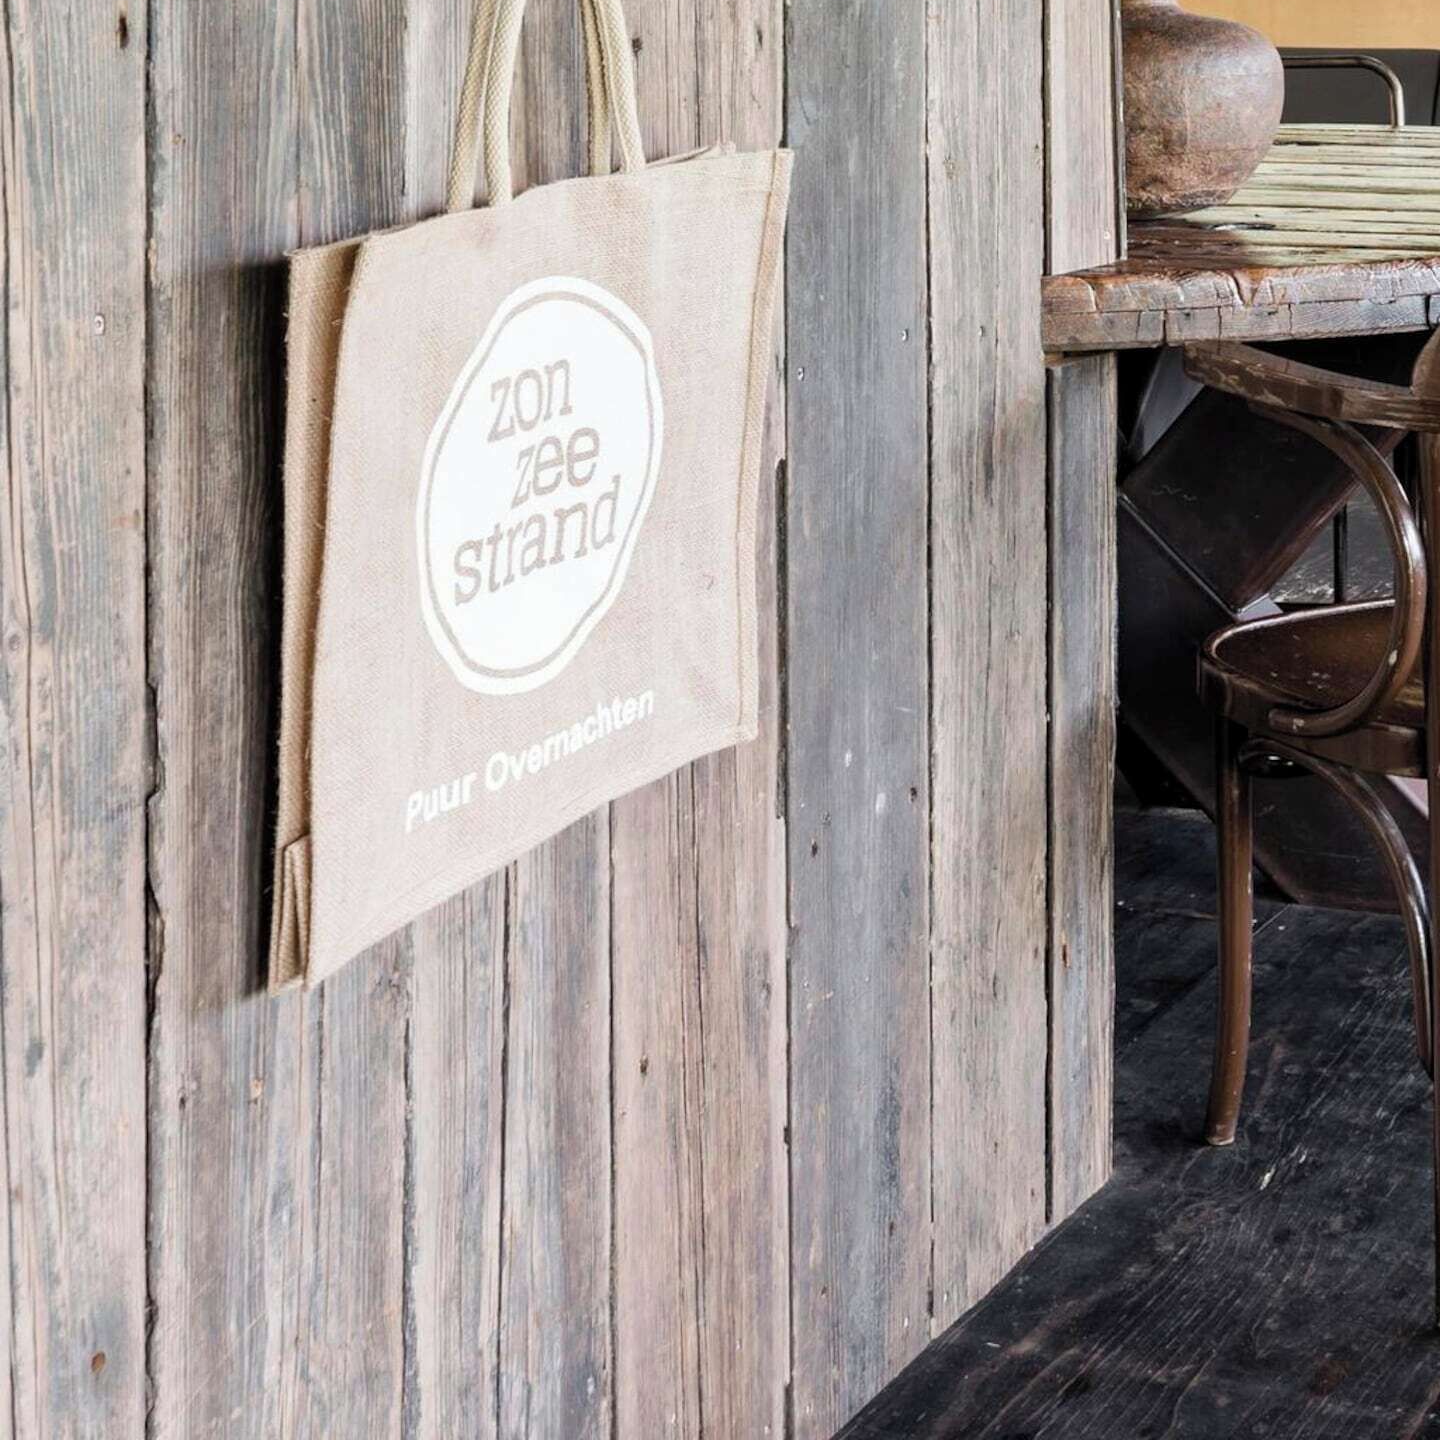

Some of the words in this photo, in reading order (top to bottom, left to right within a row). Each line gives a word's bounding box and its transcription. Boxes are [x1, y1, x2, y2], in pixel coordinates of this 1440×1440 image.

[488, 358, 573, 443] zon
[511, 426, 601, 508] zee
[454, 475, 622, 606] strand
[406, 768, 475, 833] Puur
[485, 689, 655, 793] Overnachten
